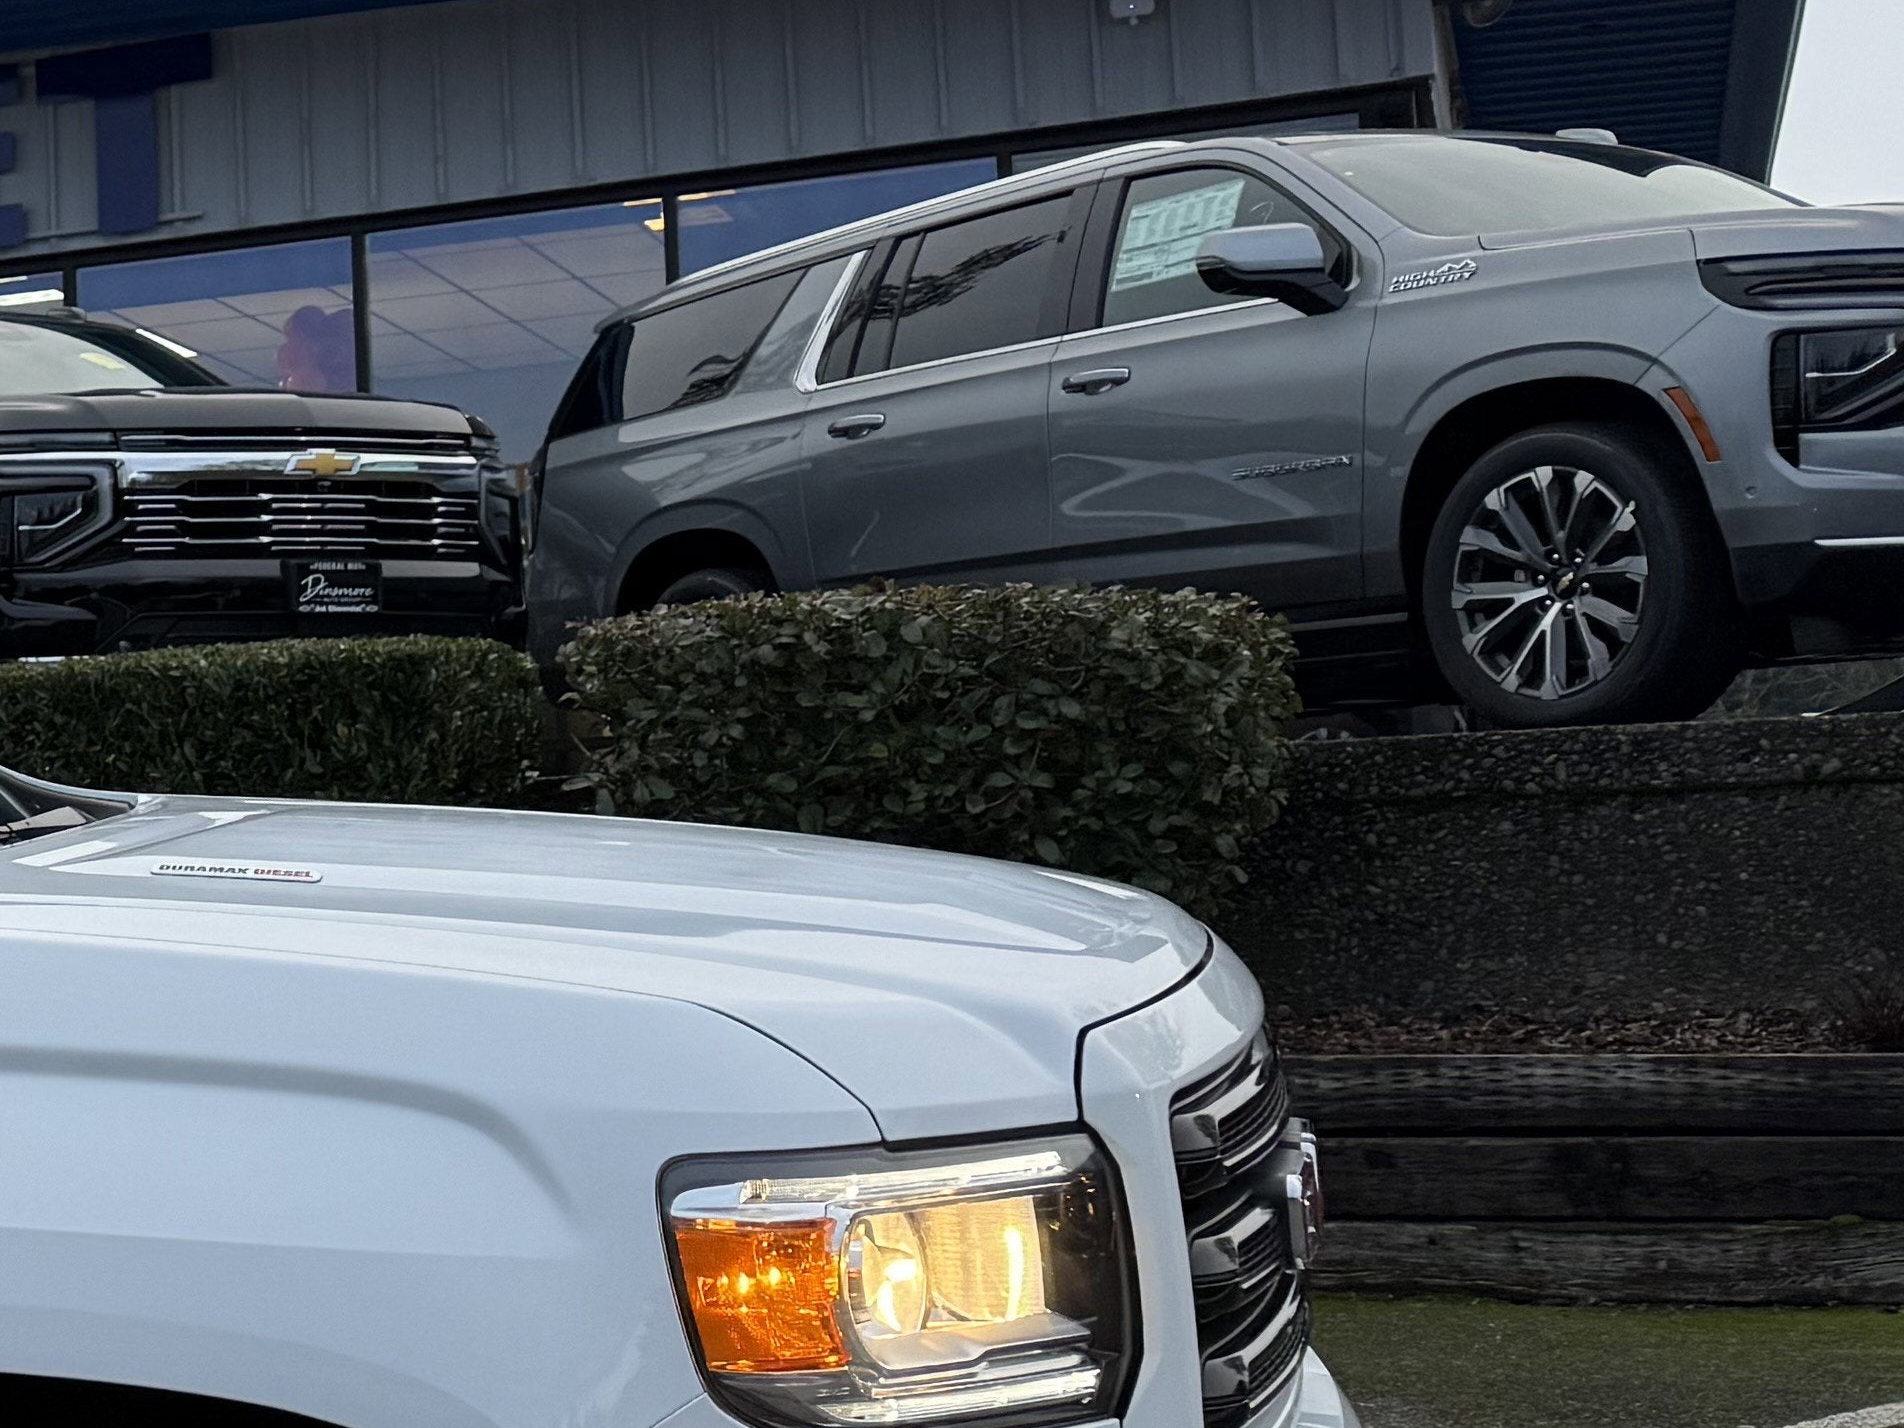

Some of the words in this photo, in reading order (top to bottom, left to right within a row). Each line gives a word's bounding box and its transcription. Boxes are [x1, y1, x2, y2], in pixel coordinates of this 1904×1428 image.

[1388, 271, 1476, 293] COUNTRY
[1392, 269, 1435, 284] HIGH
[158, 864, 249, 874] DURAMAX
[253, 868, 314, 878] DIESEL
